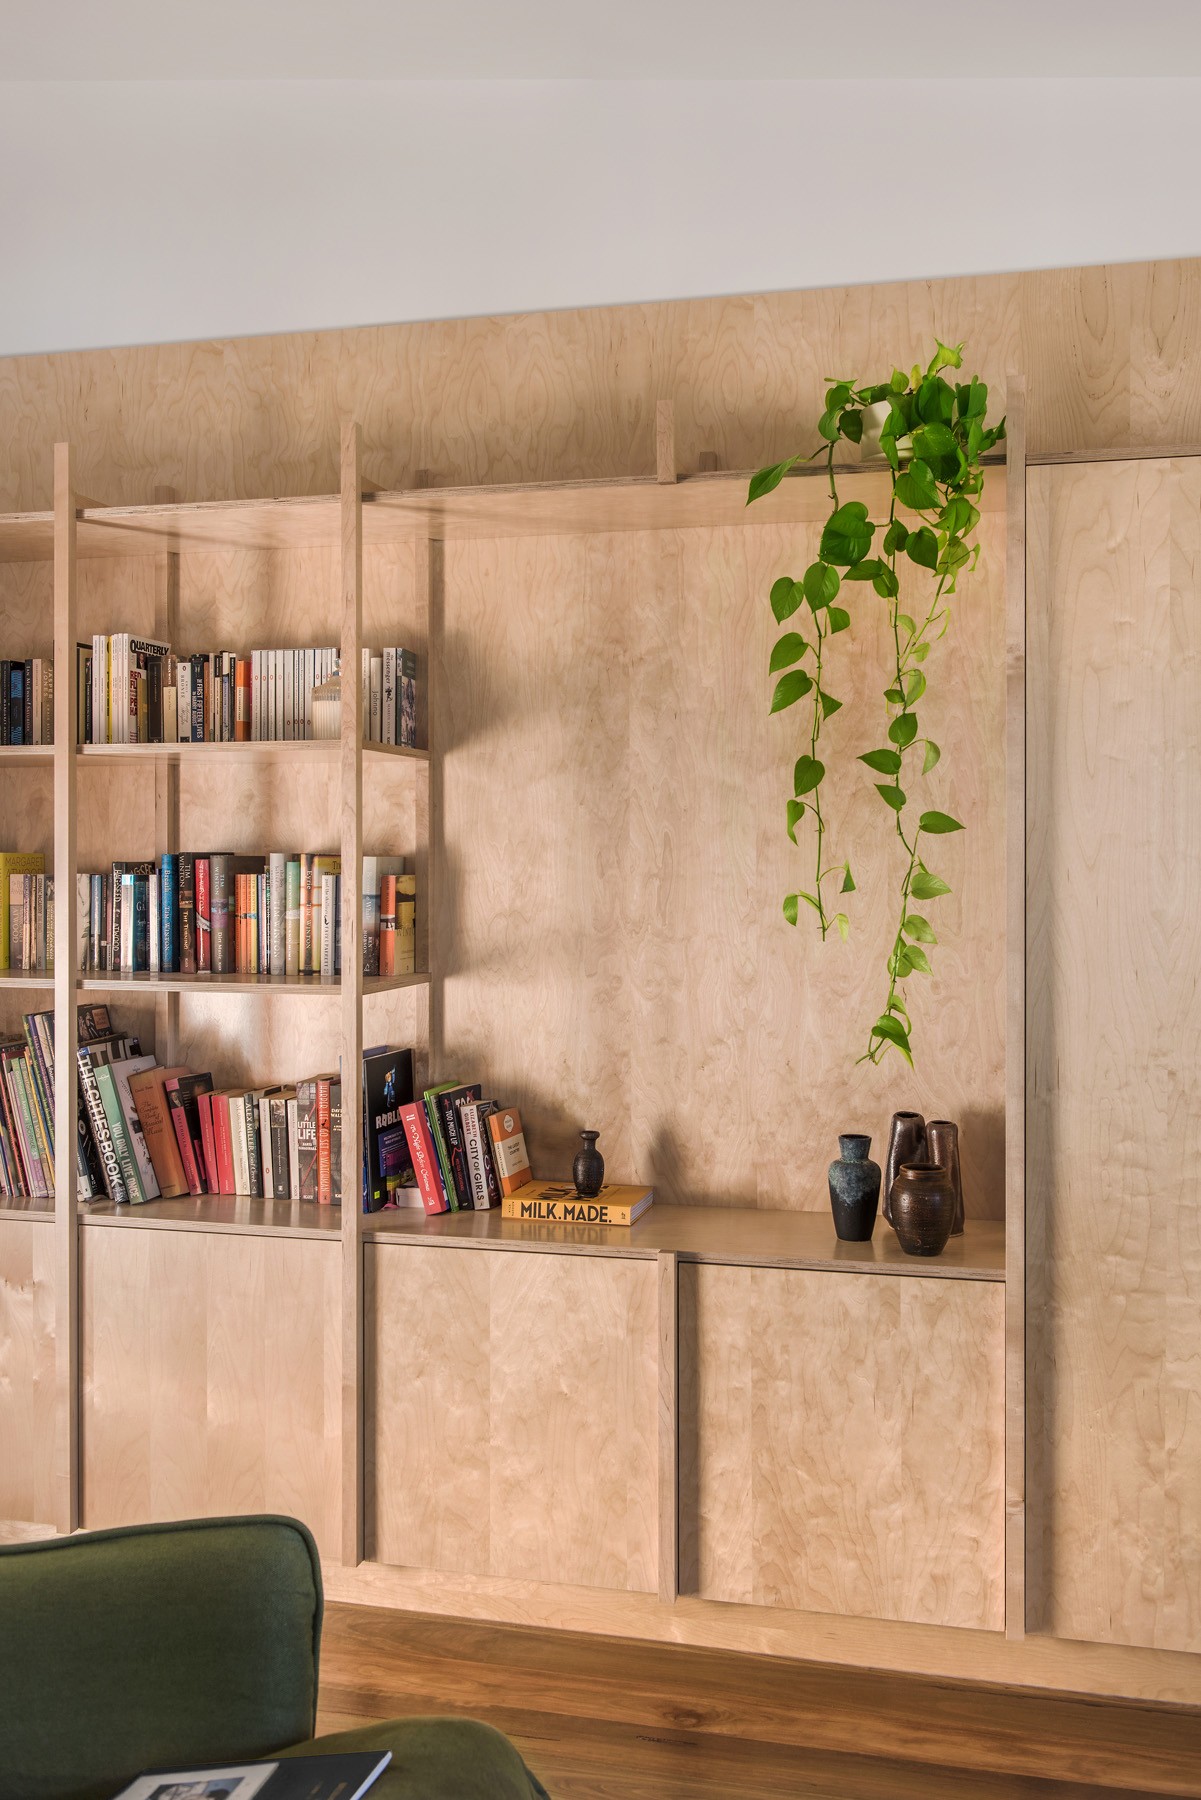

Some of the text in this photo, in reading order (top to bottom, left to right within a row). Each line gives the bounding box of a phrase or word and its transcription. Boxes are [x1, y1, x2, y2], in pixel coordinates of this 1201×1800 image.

[130, 639, 169, 656] QUARTERLY
[372, 691, 380, 717] Johnno
[5, 856, 42, 867] MARGARET
[163, 869, 171, 893] Breath
[273, 902, 281, 958] TIM WINTON
[21, 1097, 30, 1121] Answers
[318, 1084, 329, 1109] HARPER
[80, 1054, 124, 1188] THE CITIES BOOK
[245, 1102, 255, 1151] ALEX MILLER
[298, 1120, 316, 1129] LITTLE
[304, 1113, 309, 1121] A
[445, 1109, 458, 1146] TOO MUCH LIP
[463, 1111, 472, 1135] GILBERT
[469, 1107, 477, 1138] ELIZABETH
[25, 1124, 37, 1151] Science
[177, 1114, 187, 1148] BEETHOVEN
[298, 1129, 316, 1140] LIFE
[319, 1127, 329, 1138] GO
[320, 1139, 329, 1149] SET
[111, 1121, 139, 1199] YOU ONLY LIVE ONCE
[469, 1138, 486, 1201] CITY OF GIRLS
[320, 1157, 331, 1192] WATCHMAN
